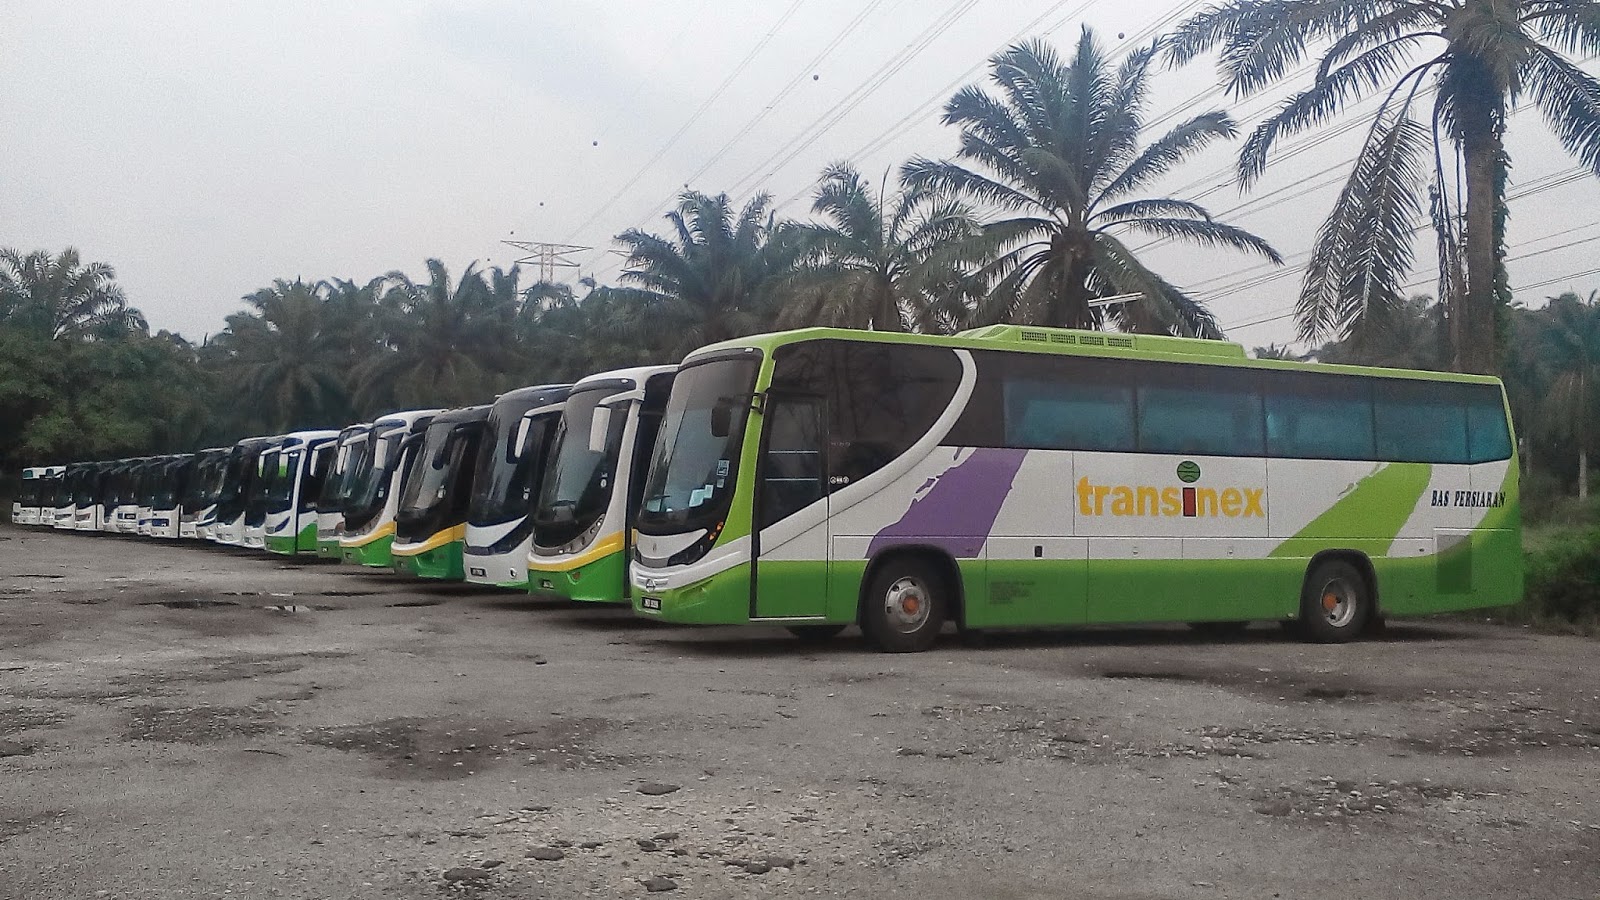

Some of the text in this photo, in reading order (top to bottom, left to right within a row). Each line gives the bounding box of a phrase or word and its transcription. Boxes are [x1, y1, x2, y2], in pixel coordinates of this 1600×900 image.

[1077, 461, 1265, 517] transinex
[1431, 490, 1506, 508] BAS PERSIARAN
